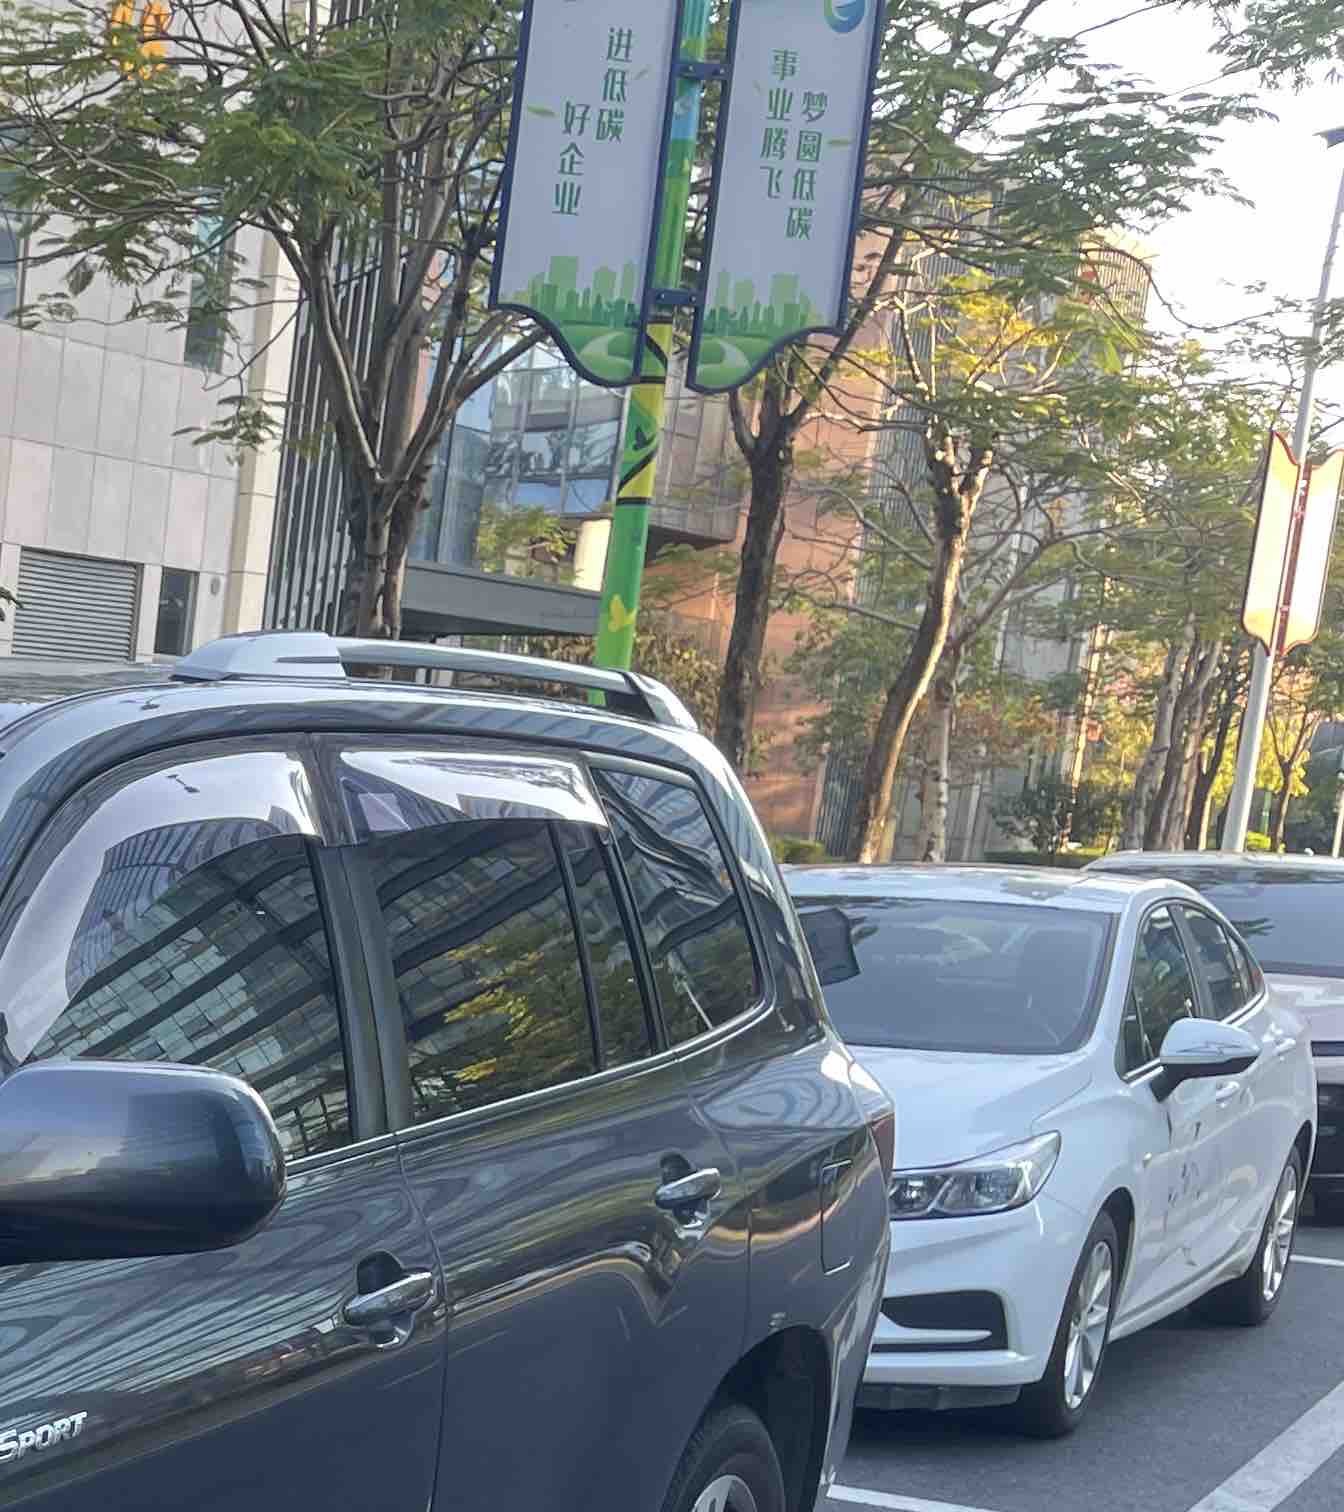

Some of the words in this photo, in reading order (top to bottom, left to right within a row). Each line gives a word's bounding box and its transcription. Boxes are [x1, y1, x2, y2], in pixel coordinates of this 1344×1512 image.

[595, 27, 633, 143] 进低碳
[760, 48, 800, 199] 事业腾飞
[552, 100, 591, 216] 好企业
[785, 91, 828, 240] 梦圆低碳
